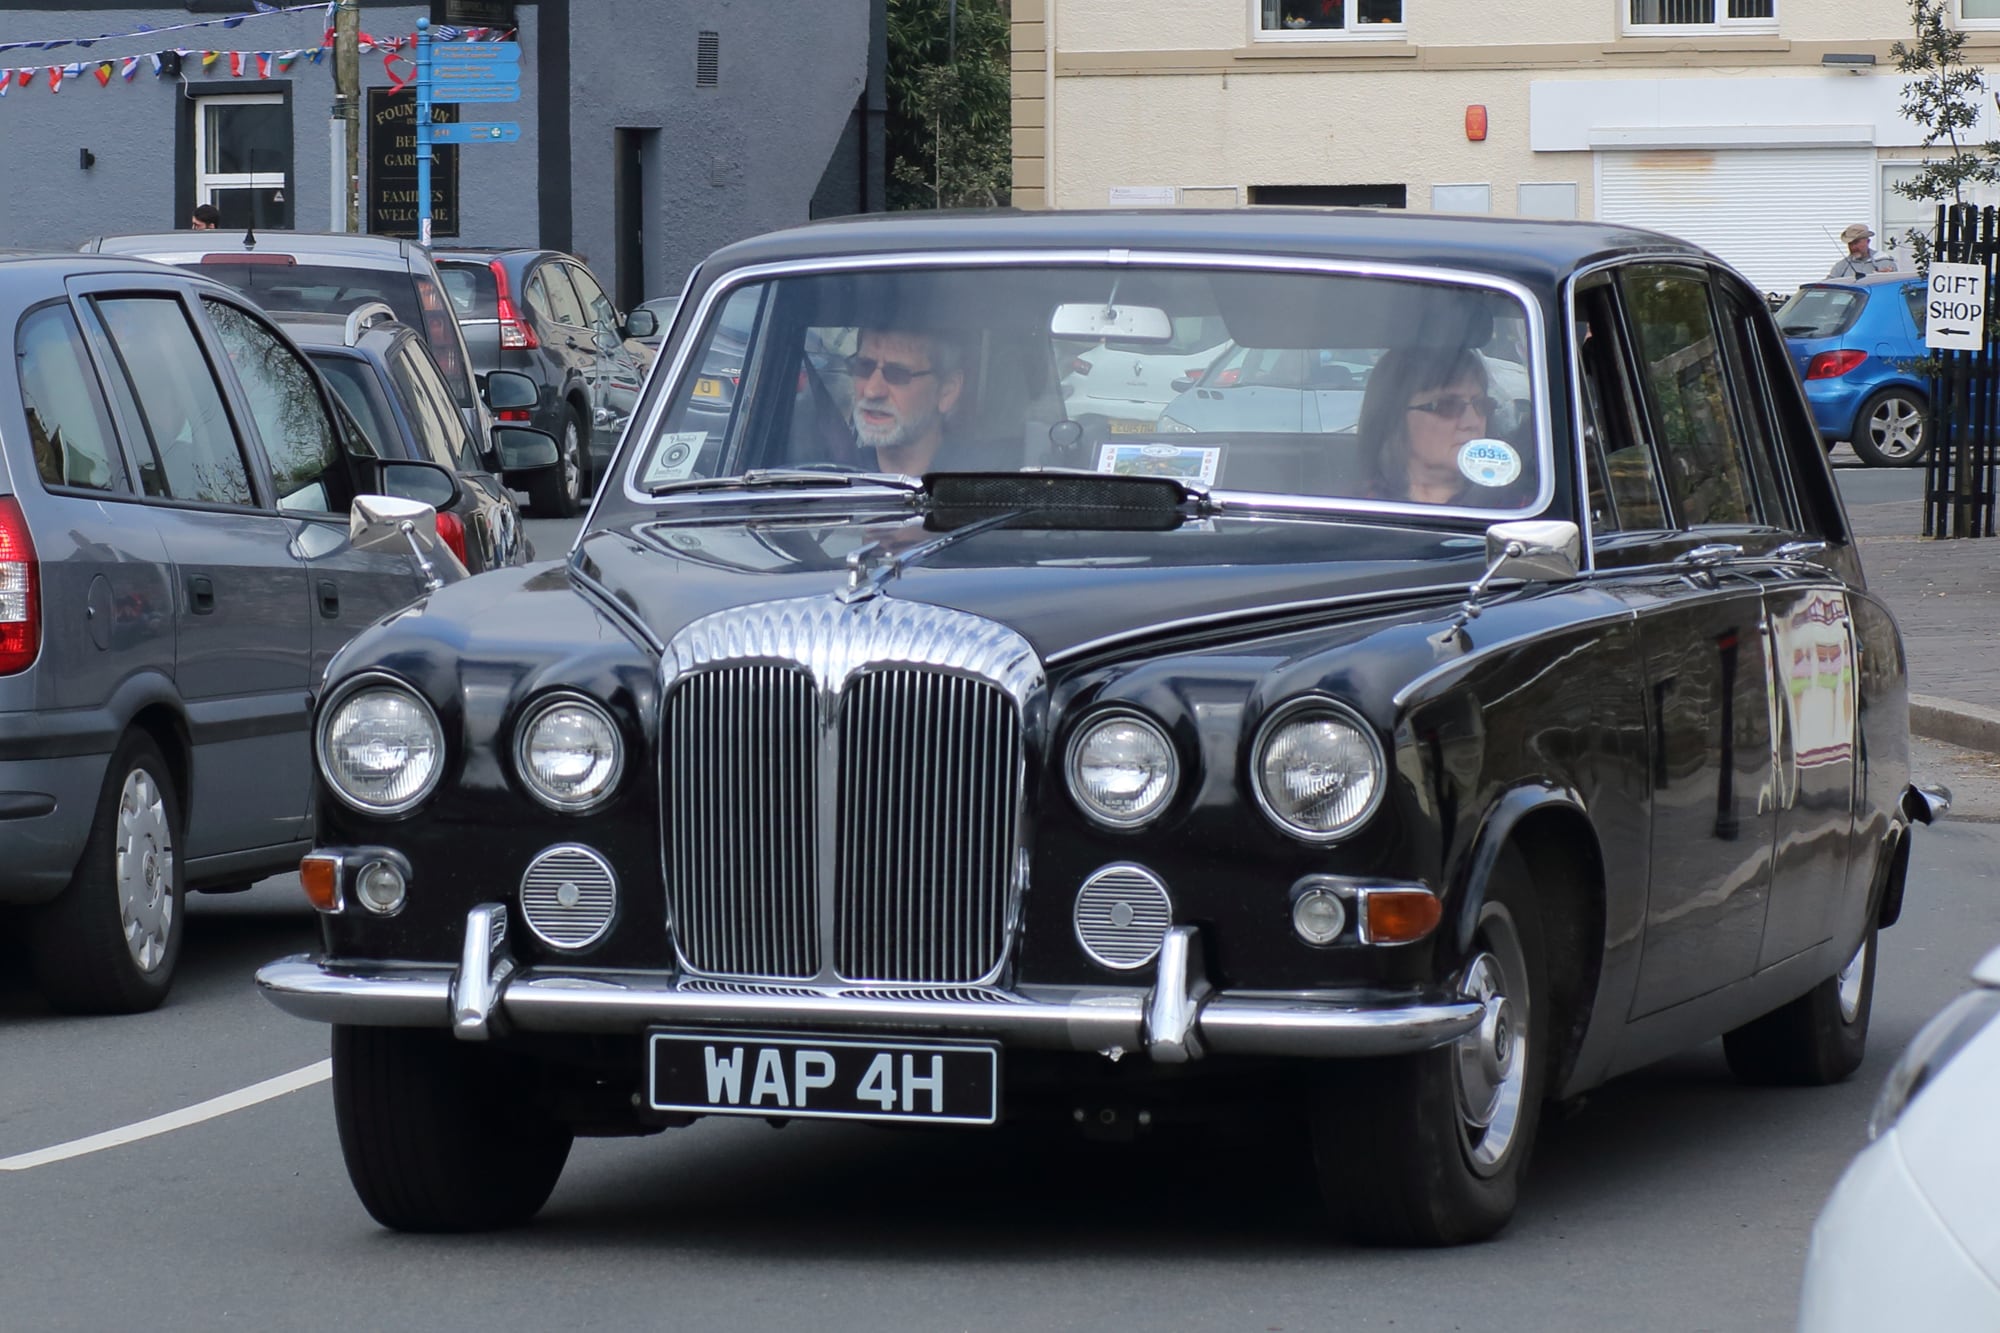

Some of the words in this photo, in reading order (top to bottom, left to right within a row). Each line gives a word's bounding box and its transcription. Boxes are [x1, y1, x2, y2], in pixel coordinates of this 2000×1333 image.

[375, 103, 450, 125] FOUNIN
[384, 153, 441, 166] GARN
[378, 208, 449, 221] WELCME
[1932, 274, 1979, 295] GIFT
[1929, 300, 1982, 321] SHOP
[1478, 447, 1496, 459] 03
[704, 1046, 836, 1107] WAP
[856, 1053, 943, 1113] 4H
